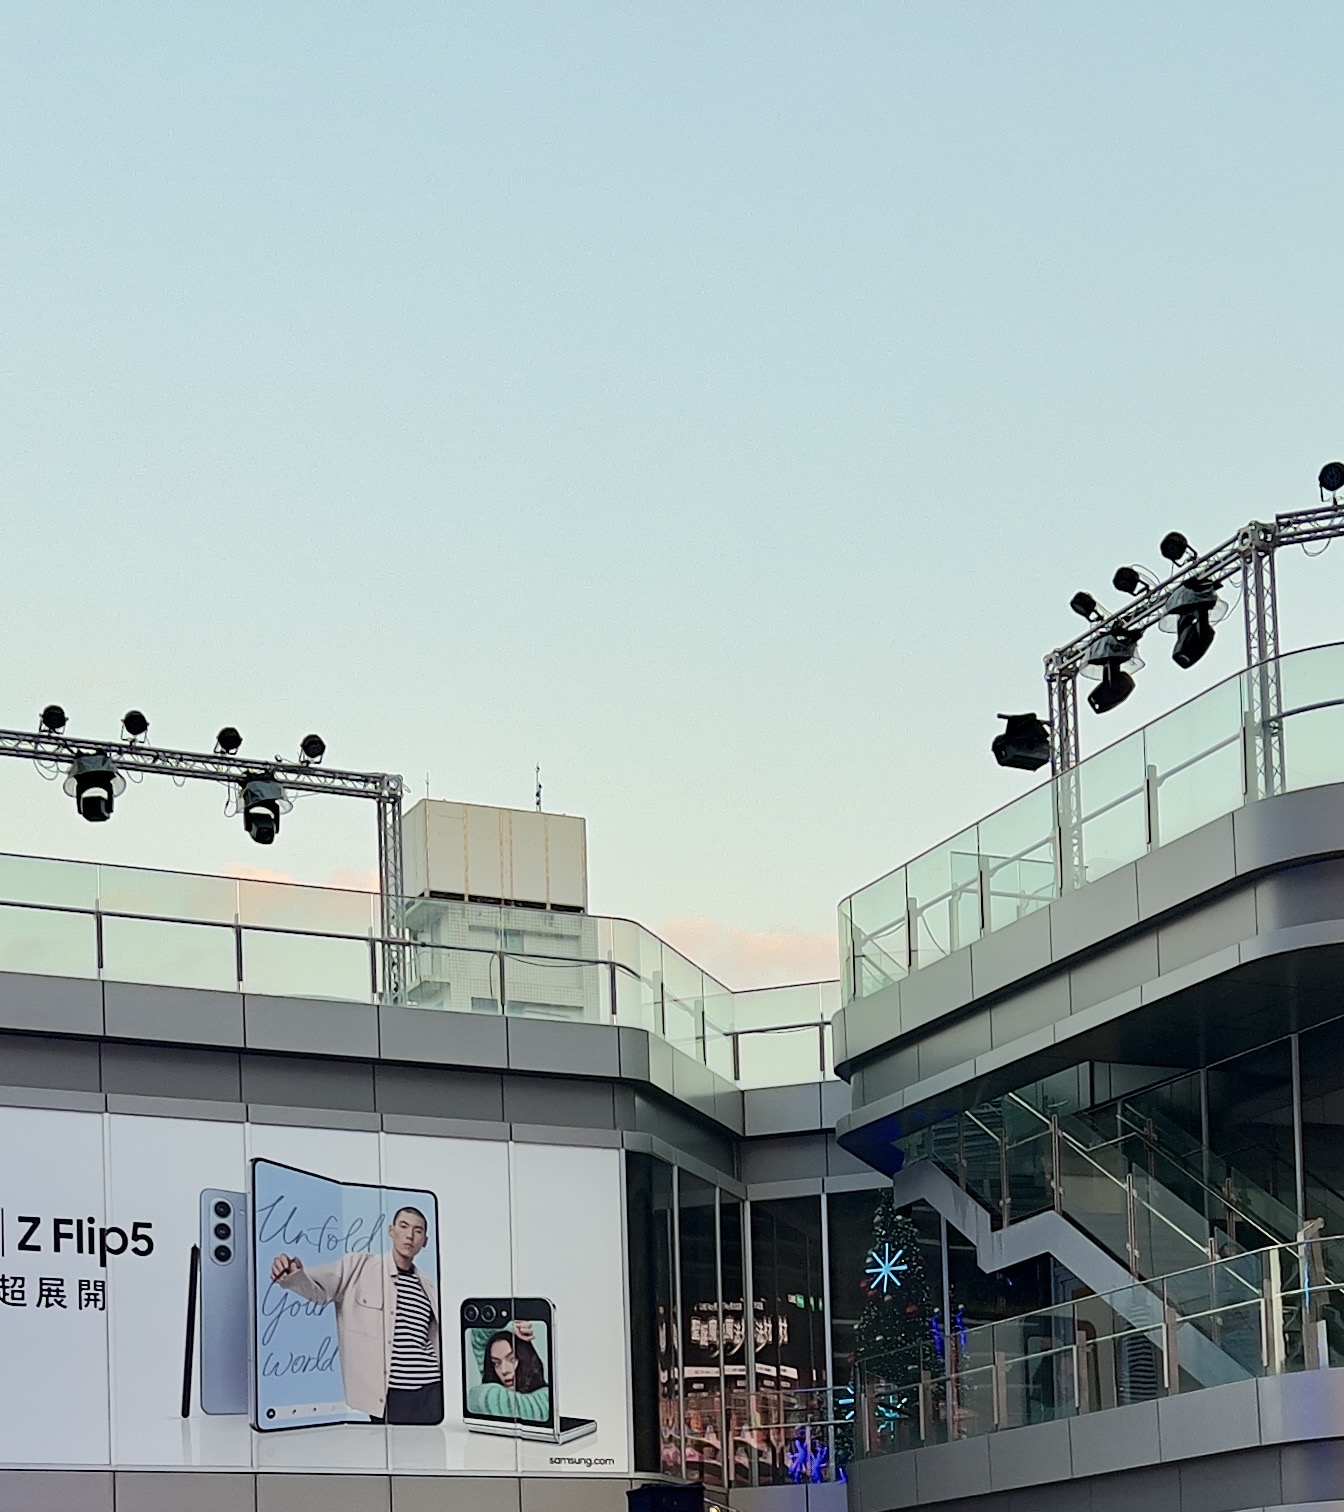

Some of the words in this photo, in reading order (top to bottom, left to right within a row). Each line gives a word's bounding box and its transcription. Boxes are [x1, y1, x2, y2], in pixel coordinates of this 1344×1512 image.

[17, 1215, 42, 1252] Z
[53, 1216, 154, 1268] Flip5
[257, 1195, 385, 1254] Unfold
[262, 1281, 334, 1346] Your
[549, 1457, 615, 1467] samsung.com
